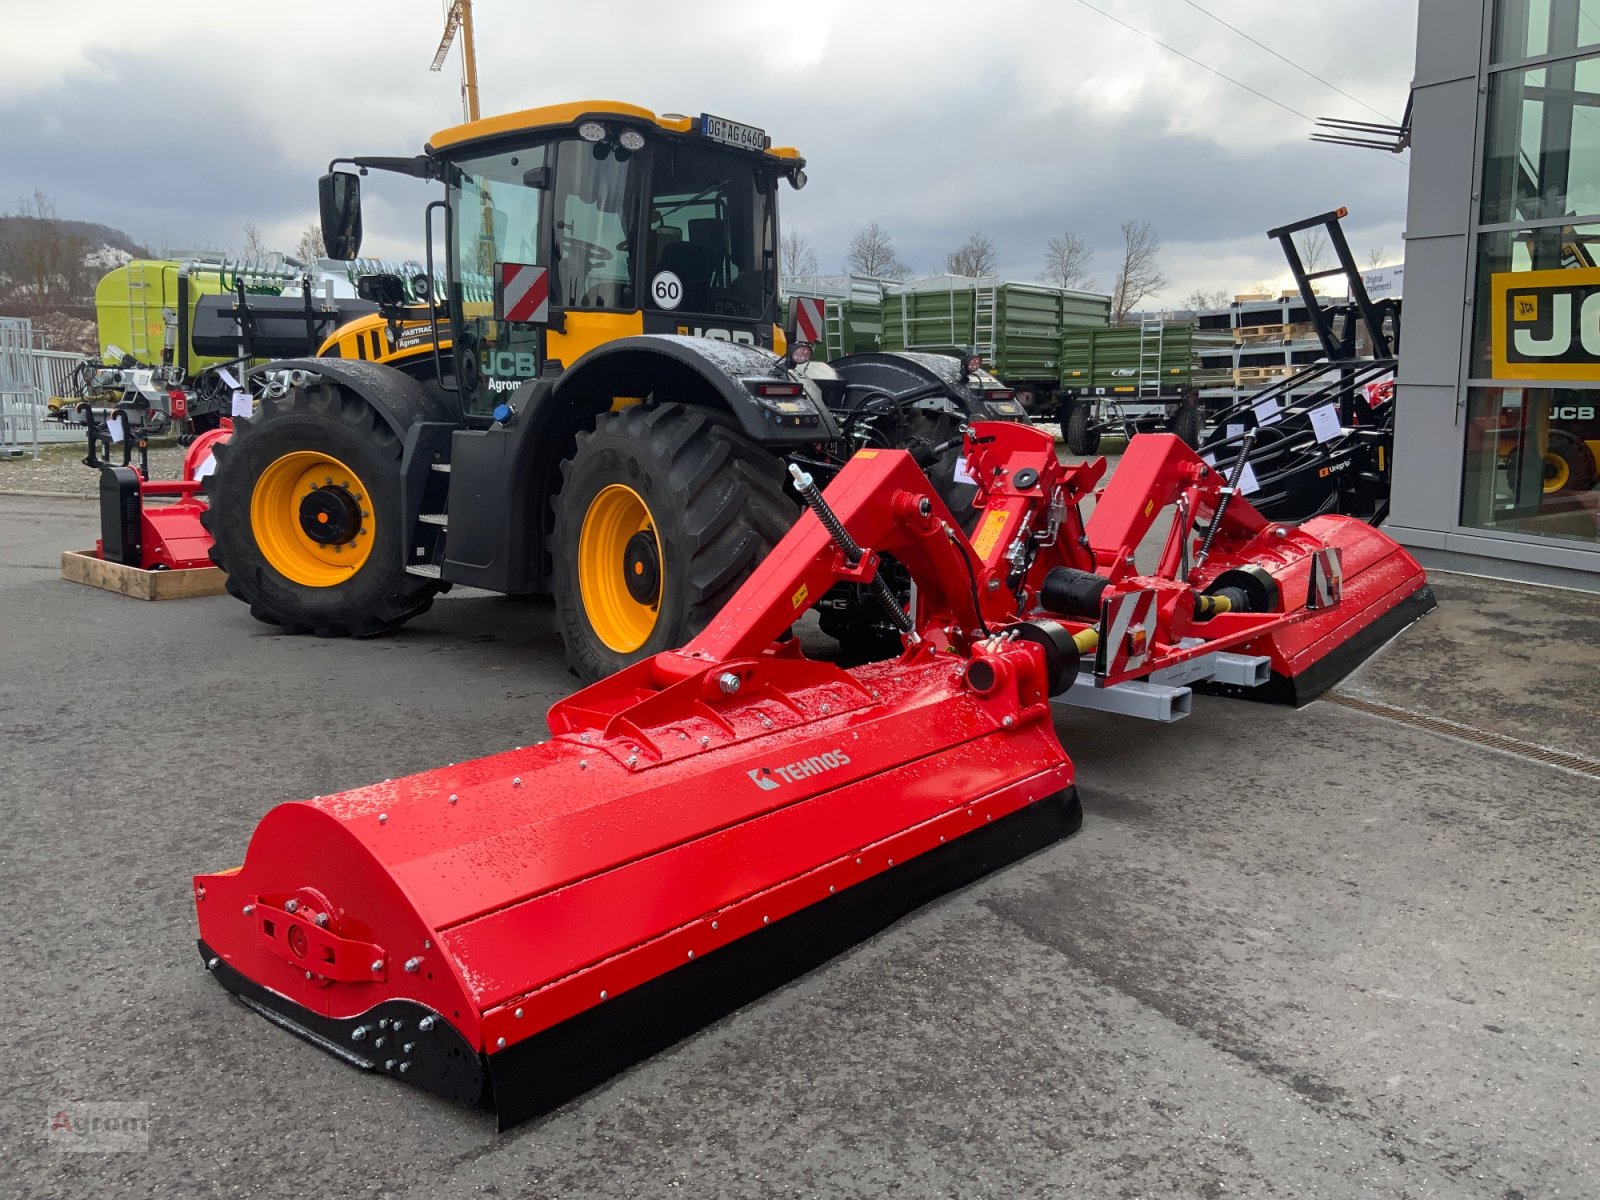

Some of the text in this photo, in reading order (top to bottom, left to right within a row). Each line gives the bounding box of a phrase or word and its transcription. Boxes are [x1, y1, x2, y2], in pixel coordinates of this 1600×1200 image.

[708, 119, 764, 149] OG AG 6460
[655, 281, 679, 300] 60
[1518, 301, 1536, 316] JCB
[399, 338, 420, 348] Agrom
[481, 351, 536, 377] JCB
[488, 377, 522, 394] Agrom
[1549, 406, 1595, 420] JCB
[1329, 460, 1351, 473] Unigrip
[773, 748, 852, 783] TEHNOS
